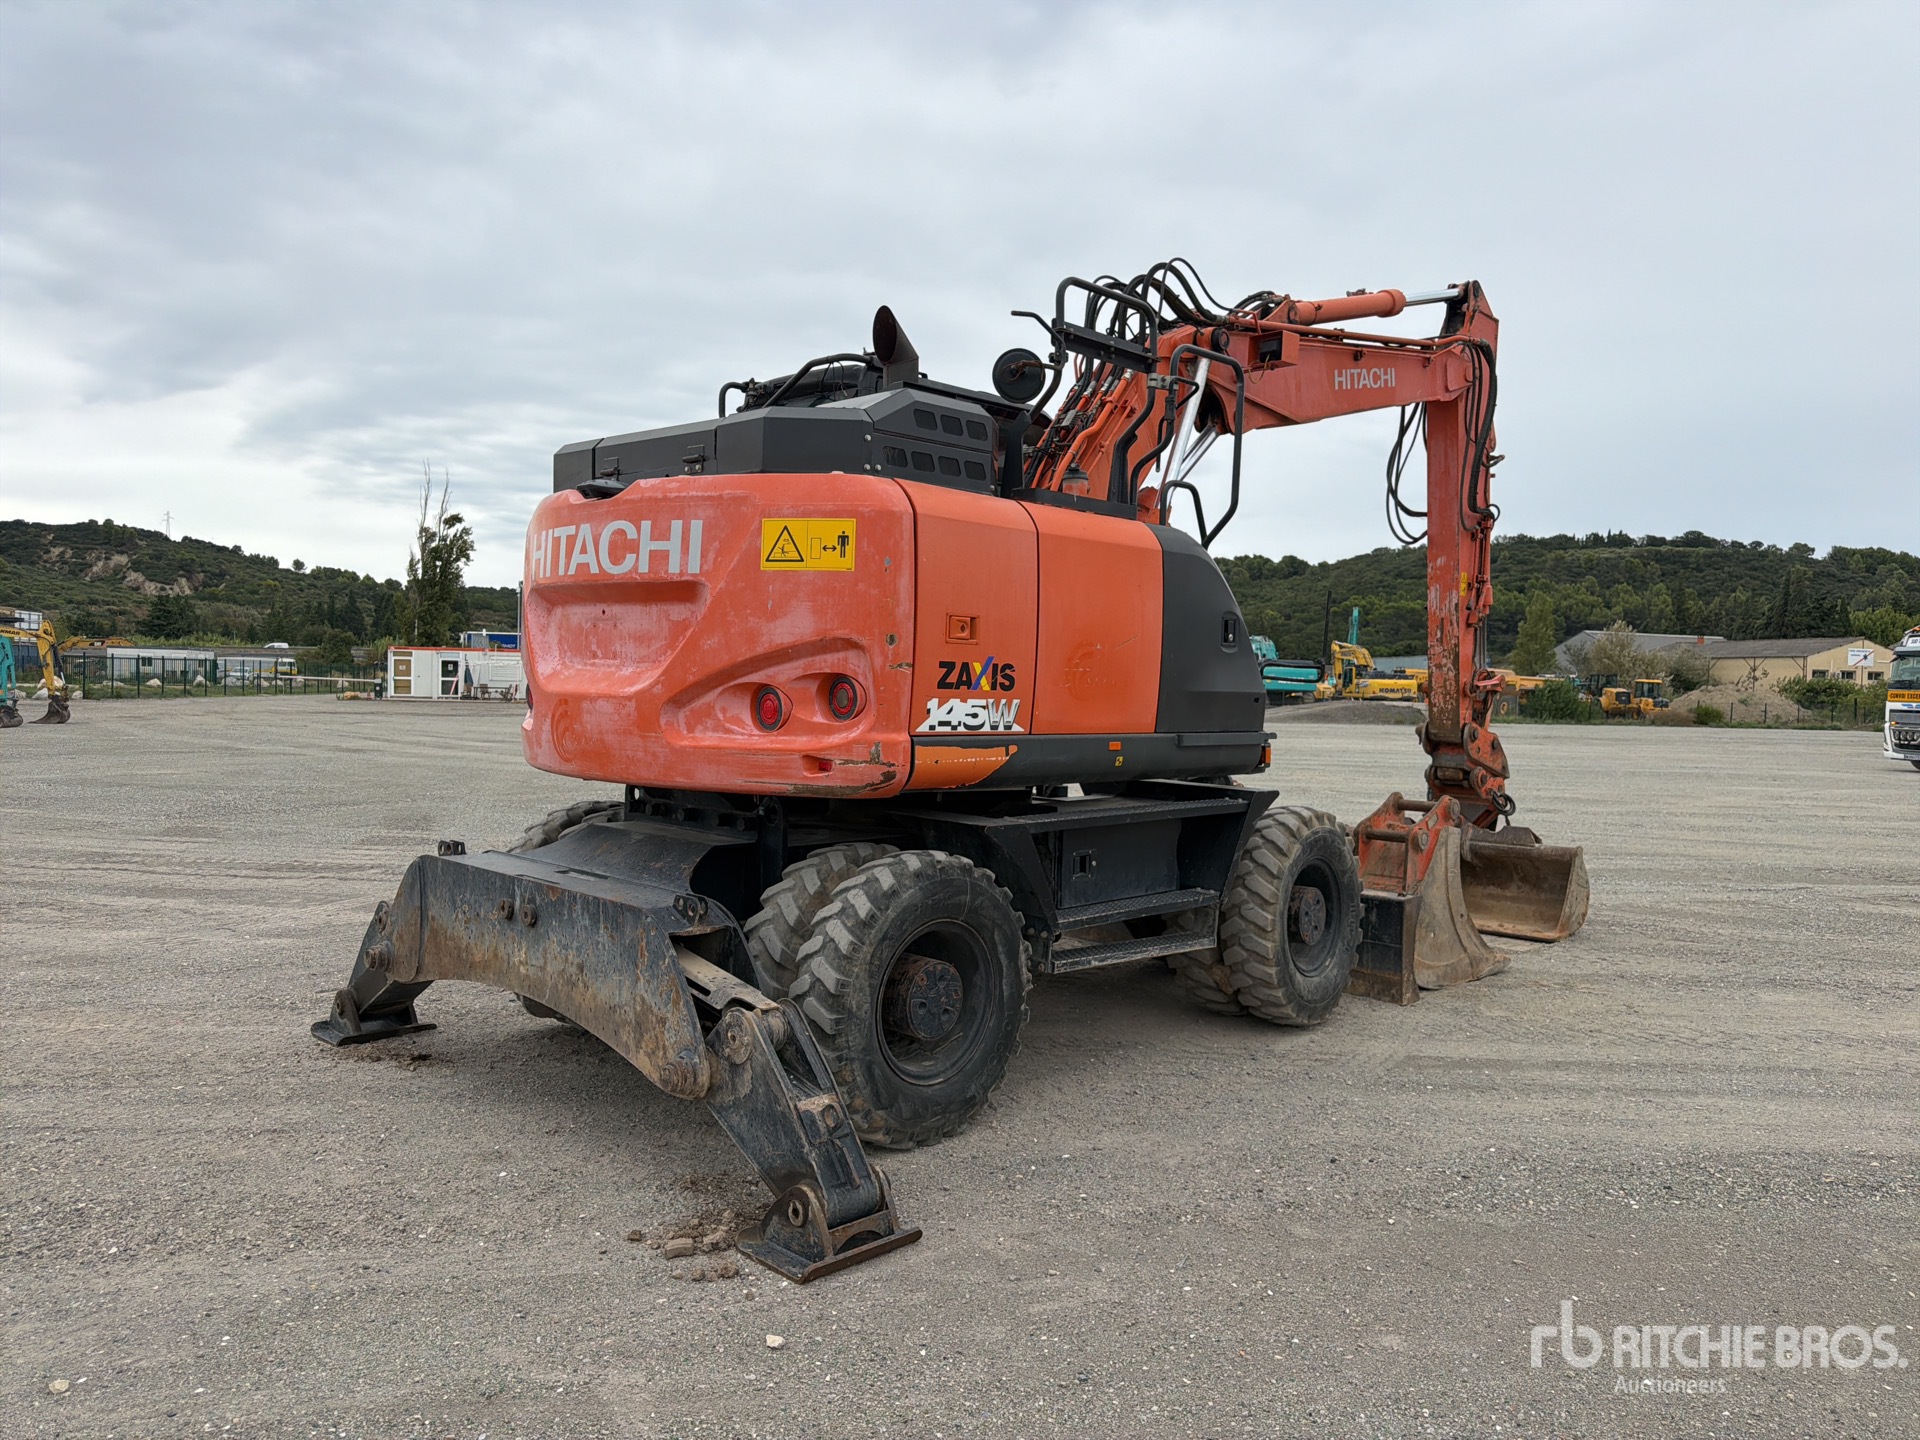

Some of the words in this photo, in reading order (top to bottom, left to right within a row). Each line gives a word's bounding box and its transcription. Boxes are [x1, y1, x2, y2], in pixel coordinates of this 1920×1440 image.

[1334, 368, 1396, 390] HITACHI
[531, 519, 703, 581] HITACHI
[937, 656, 1016, 691] ZAXIS
[923, 697, 1021, 731] 145W
